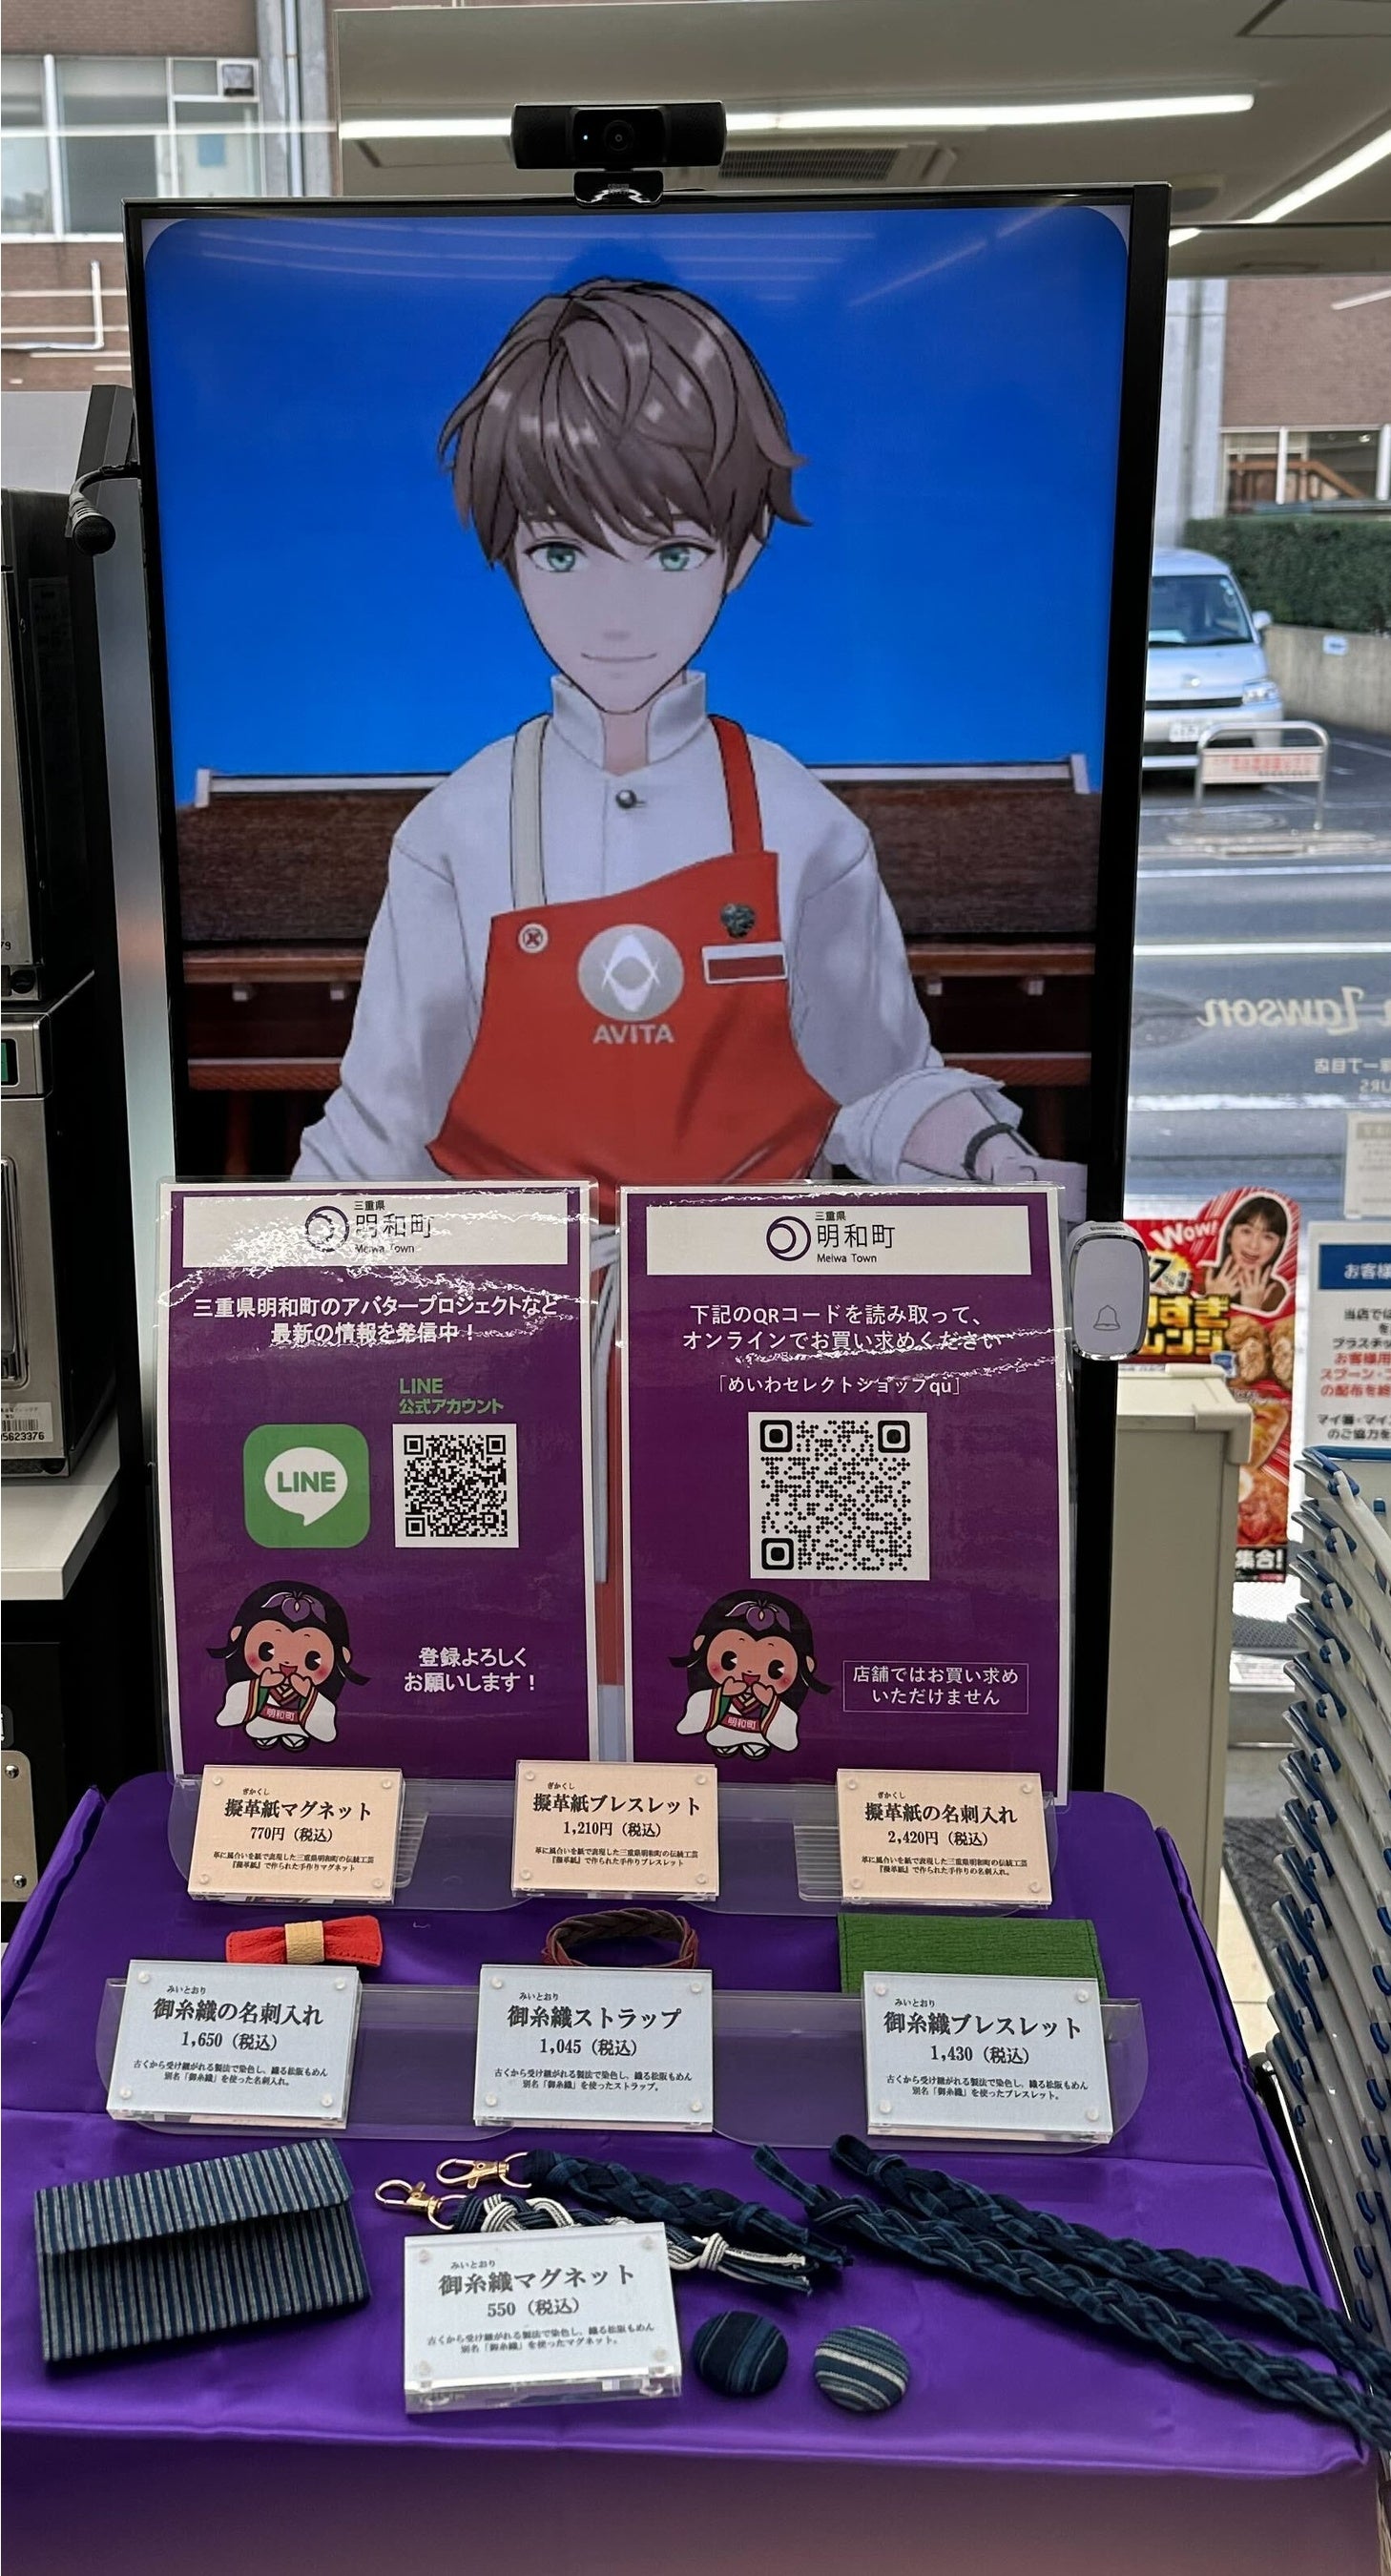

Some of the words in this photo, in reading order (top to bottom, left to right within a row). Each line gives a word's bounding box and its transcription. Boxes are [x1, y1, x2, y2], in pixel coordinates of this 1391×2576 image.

[593, 1024, 675, 1045] AVITA
[354, 1200, 385, 1212] 三重県
[815, 1211, 847, 1222] 三重県
[817, 1224, 896, 1250] 明和町
[817, 1253, 847, 1264] Meiwa
[851, 1253, 878, 1264] Town
[193, 1296, 558, 1319] 三重県明和町のアバタープロジェクトなど
[690, 1304, 983, 1326] 下記のQRコードを読み取って、
[271, 1323, 474, 1344] 最新の情報を発信中！
[683, 1331, 1003, 1352] オンラインでお買い求めください
[399, 1378, 444, 1394] LINE
[399, 1398, 505, 1415] 公式アカウント
[1, 1431, 45, 1442] 5623376
[277, 1471, 336, 1493] LINE
[418, 1647, 528, 1668] 登録よろしく
[404, 1672, 536, 1693] お願いします！
[853, 1666, 1019, 1685] 店舗ではお買い求め
[872, 1687, 1001, 1706] いただけません
[267, 1707, 295, 1722] 明和町
[728, 1716, 757, 1730] 明和町
[224, 1798, 371, 1821] 擬革紙マグネット
[532, 1793, 700, 1816] 擬革紙ブレスレット
[864, 1802, 1018, 1824] 擬革紙の名刺入れ
[166, 1984, 207, 1995] みいとおり
[519, 1992, 559, 2002] みいとおり
[152, 1998, 323, 2026] 御糸織の名刺入れ
[894, 1998, 936, 2007] みいとおり
[508, 2005, 682, 2029] 御糸織ストラップ
[883, 2011, 1081, 2040] 御糸織ブレスレット
[450, 2260, 496, 2270] みいとおり
[438, 2264, 634, 2296] 御糸織マグネット
